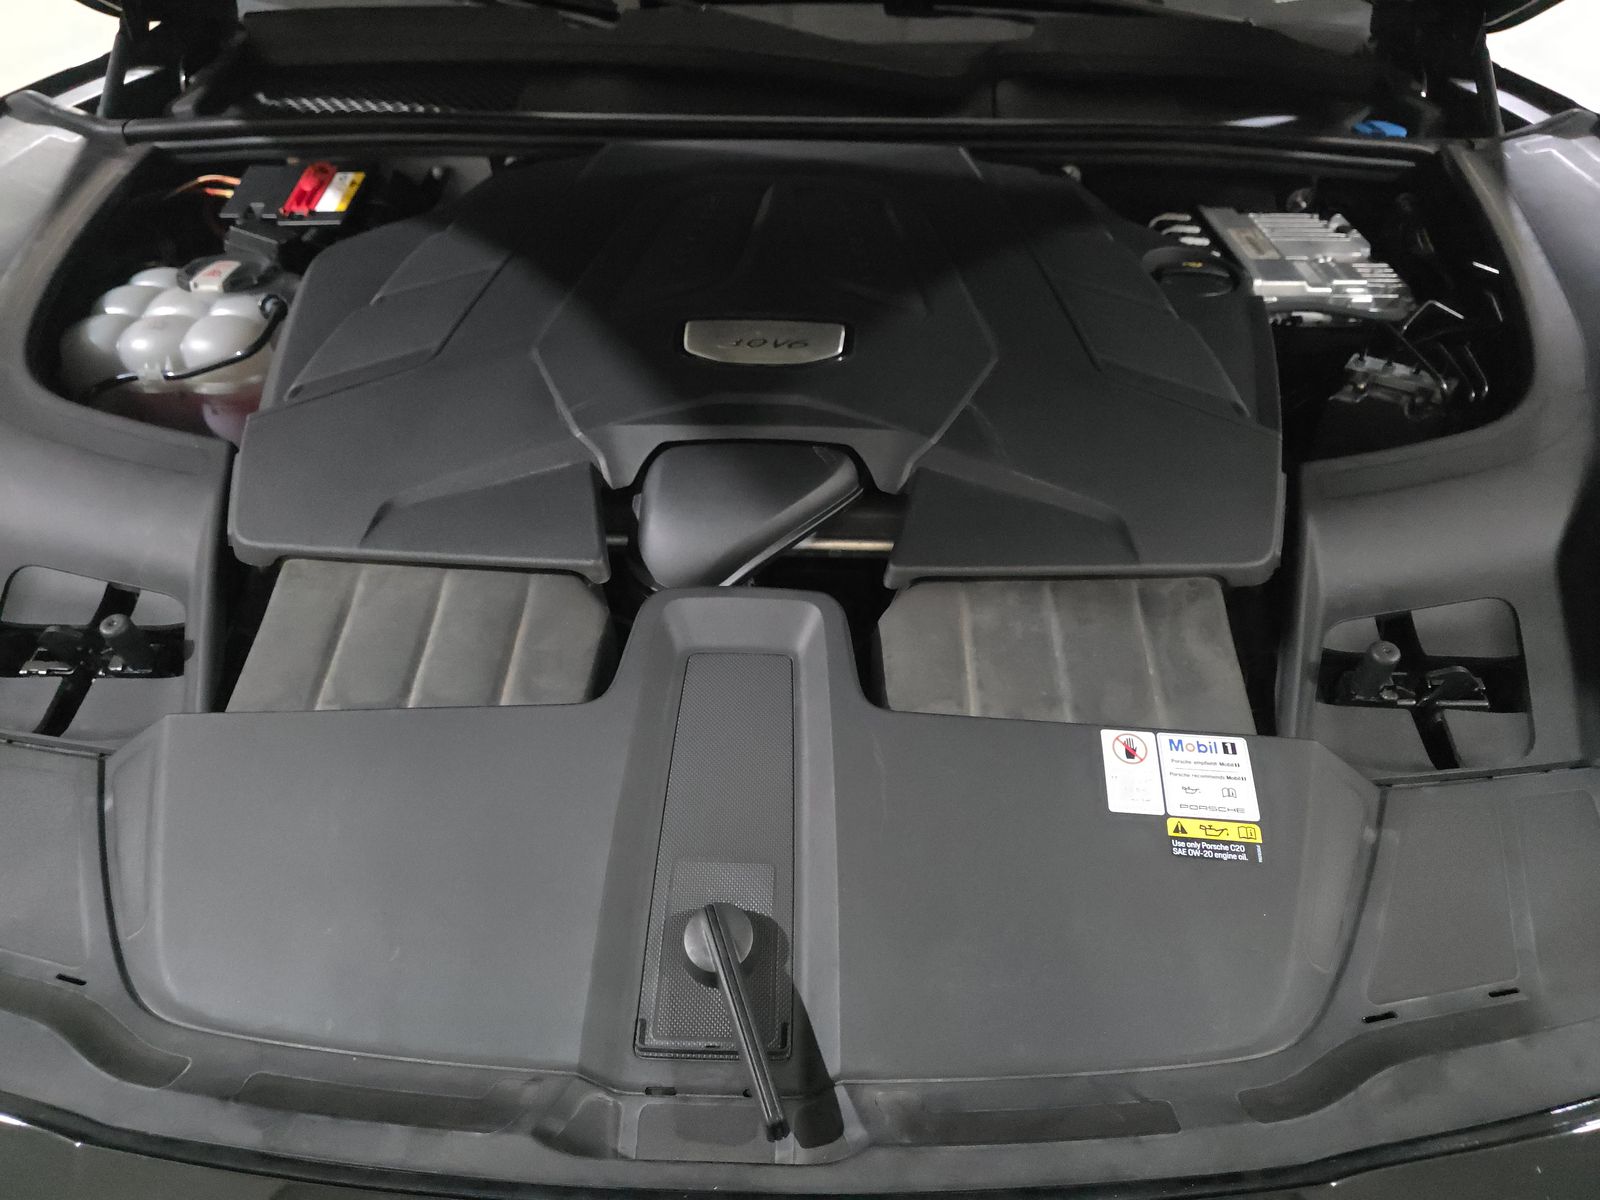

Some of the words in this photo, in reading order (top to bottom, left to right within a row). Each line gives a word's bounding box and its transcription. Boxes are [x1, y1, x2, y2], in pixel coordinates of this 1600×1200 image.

[1169, 739, 1218, 754] Mobil
[1221, 742, 1237, 755] 1
[1179, 803, 1246, 814] PORSCHE
[1171, 840, 1185, 848] Use
[1186, 841, 1200, 850] only
[1201, 842, 1230, 851] Porsche
[1230, 845, 1246, 853] C20
[1172, 847, 1187, 856] SAE
[1214, 851, 1238, 861] engine
[1238, 853, 1249, 861] oil.
